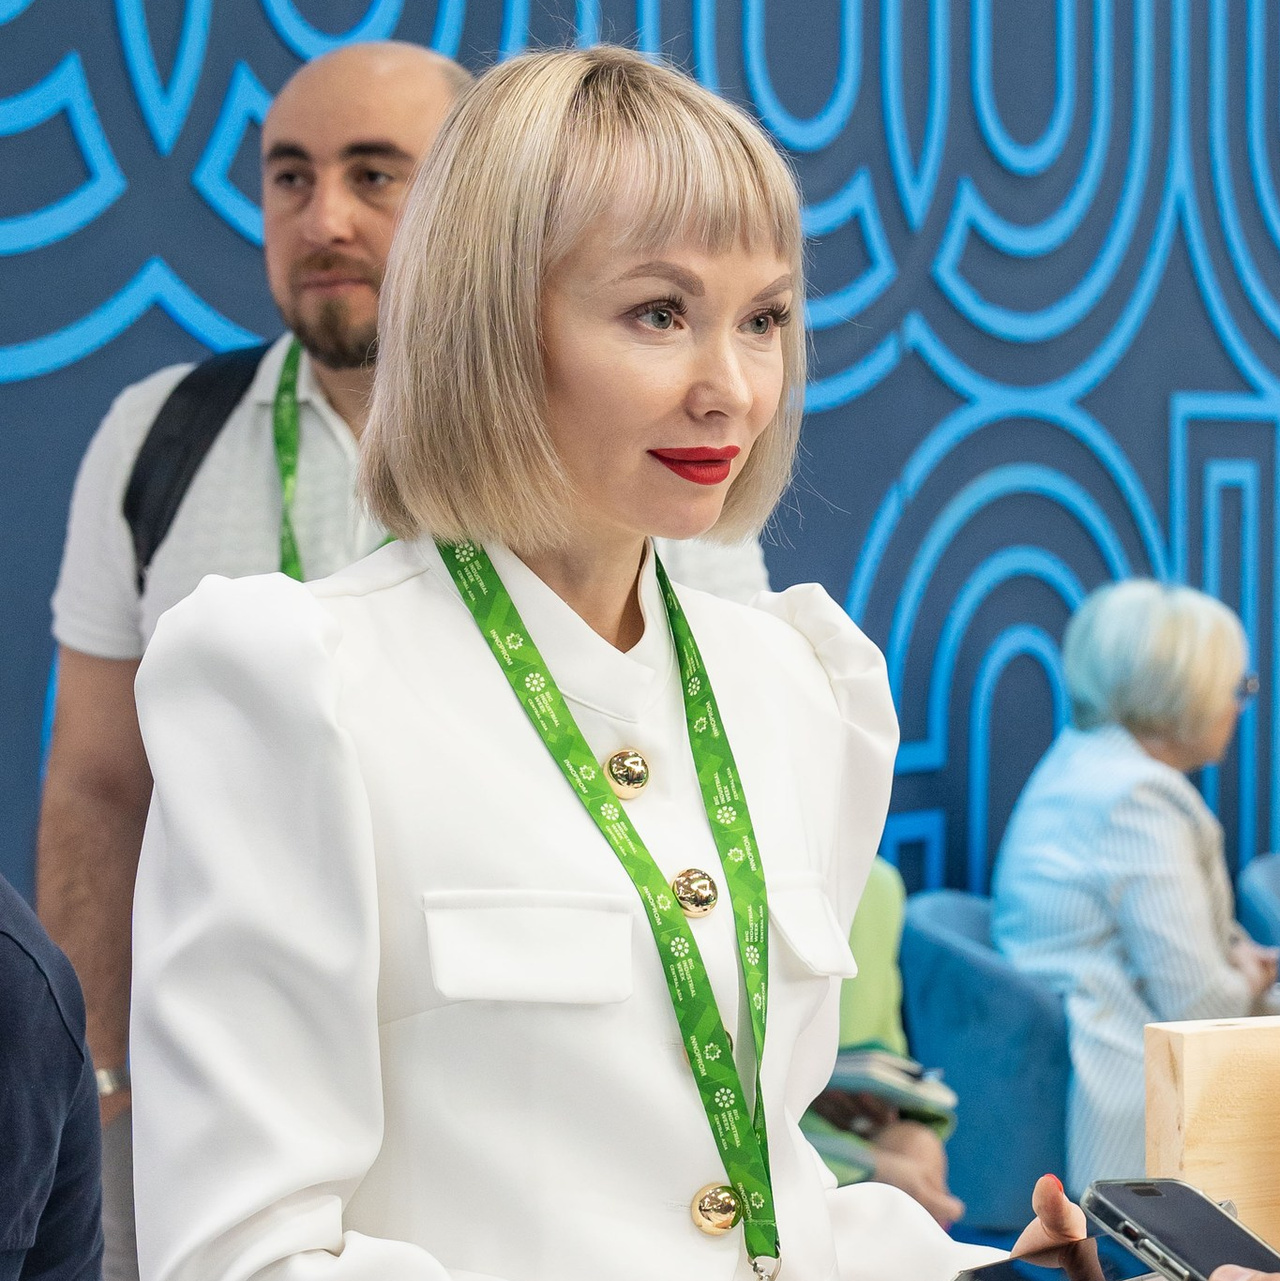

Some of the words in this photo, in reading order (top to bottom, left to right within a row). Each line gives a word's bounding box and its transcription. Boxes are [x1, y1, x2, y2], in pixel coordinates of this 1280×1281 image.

[489, 628, 514, 666] INNOPROM
[563, 758, 589, 794] INNOPROM
[742, 835, 757, 872] INNOPROM
[642, 885, 663, 926] INNOPROM
[676, 961, 687, 982] WEEK
[682, 959, 697, 999] INDUSTRIAL
[689, 1034, 708, 1077] INNOPROM
[713, 1113, 724, 1137] CENTRAL
[720, 1111, 730, 1132] WEEK
[727, 1109, 742, 1149] INDUSTRIAL
[732, 1108, 740, 1121] BIG
